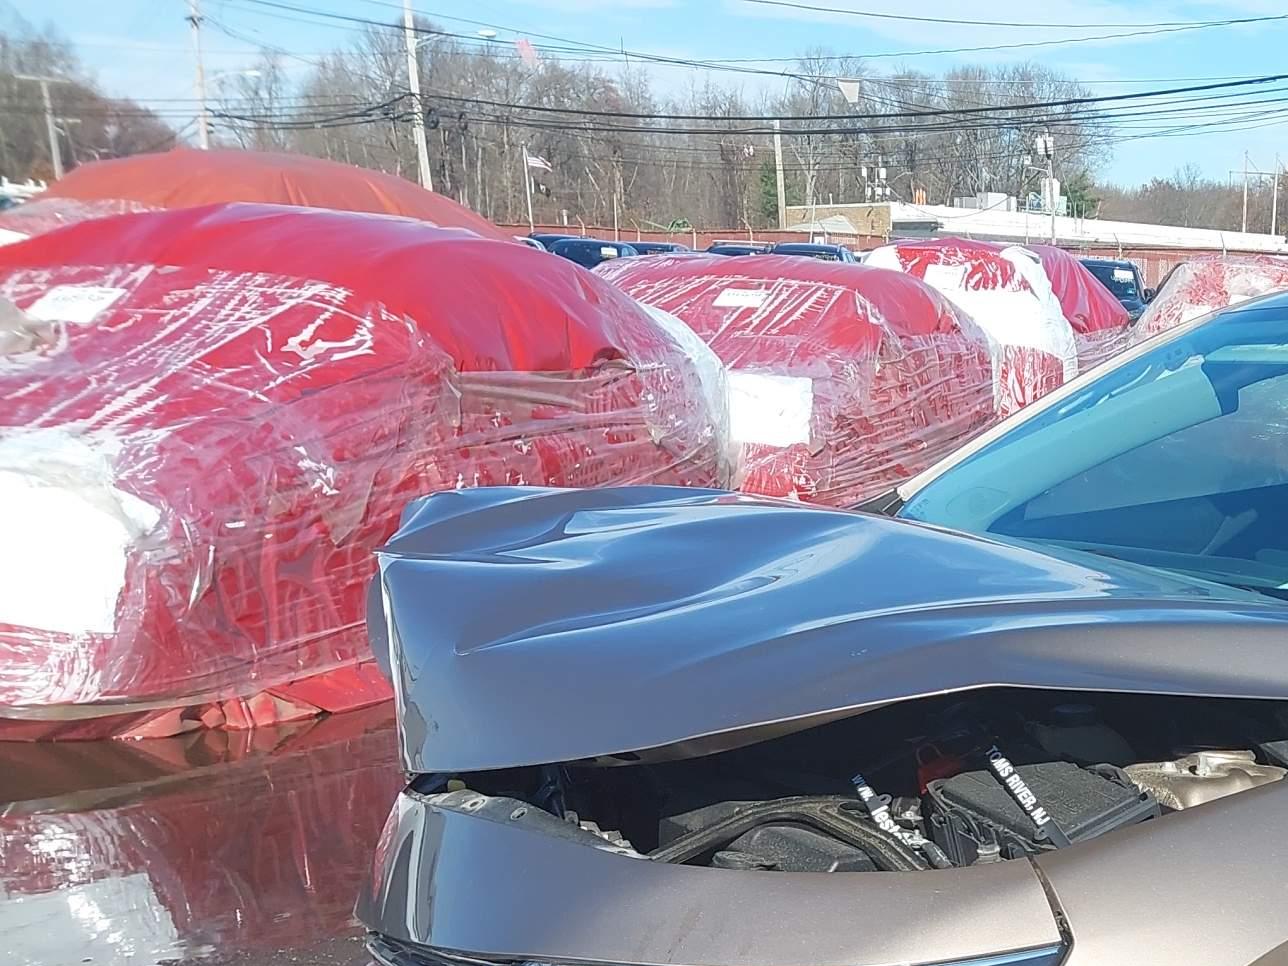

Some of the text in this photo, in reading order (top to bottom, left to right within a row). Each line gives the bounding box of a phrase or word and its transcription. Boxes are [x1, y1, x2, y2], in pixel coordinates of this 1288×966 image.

[985, 744, 1051, 826] TOMS RIVER, NJ
